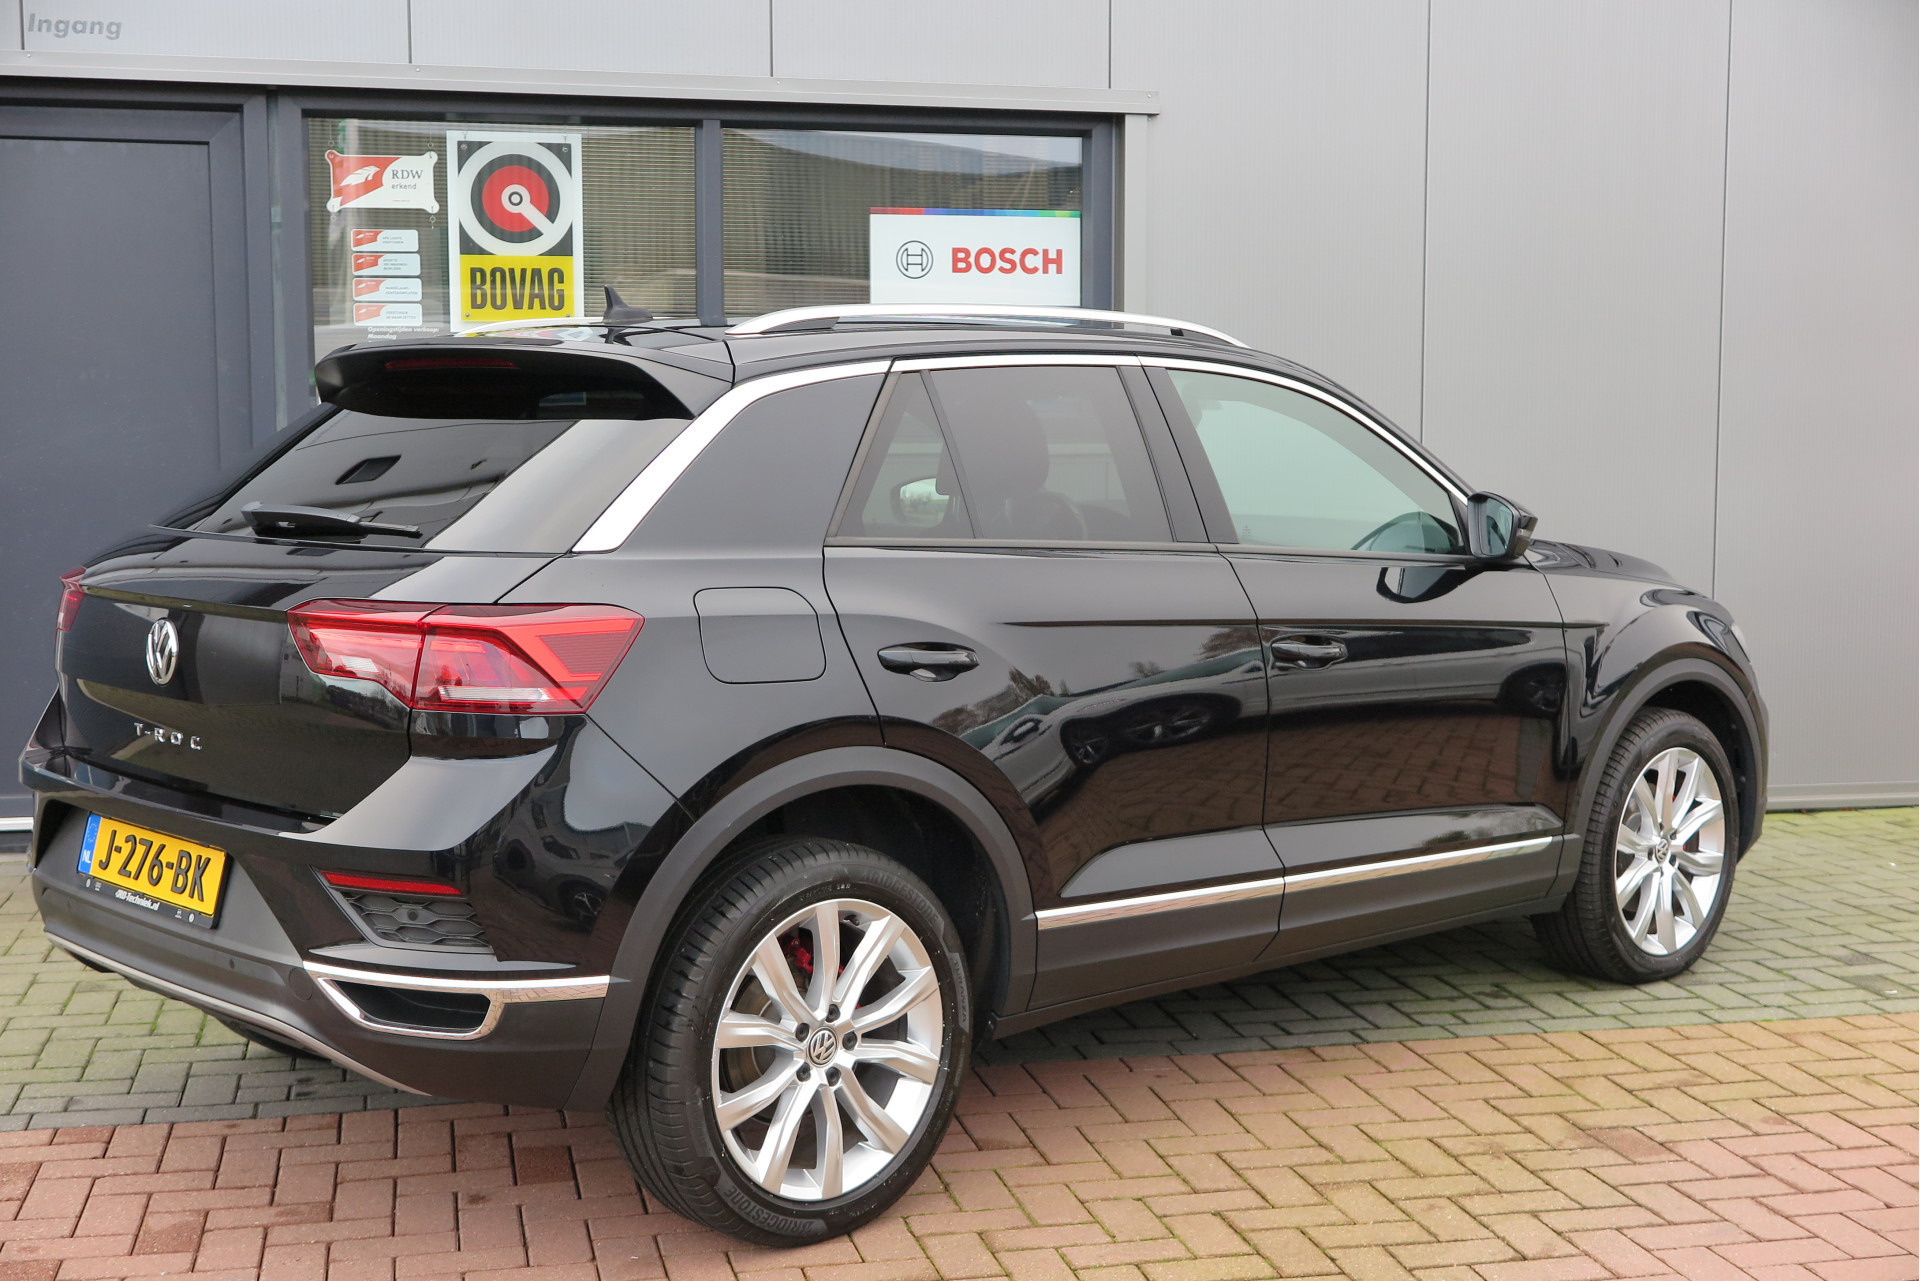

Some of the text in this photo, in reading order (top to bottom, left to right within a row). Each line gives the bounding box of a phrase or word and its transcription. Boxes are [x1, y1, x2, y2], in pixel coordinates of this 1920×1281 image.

[27, 13, 122, 40] Ingang
[391, 169, 423, 180] RDW
[951, 247, 1063, 275] BOSCH
[469, 267, 565, 311] BOVAG
[133, 722, 203, 751] T-ROC
[81, 850, 92, 864] NL
[98, 829, 211, 902] J-276-BK
[723, 1185, 814, 1237] BRIDGESTONE
